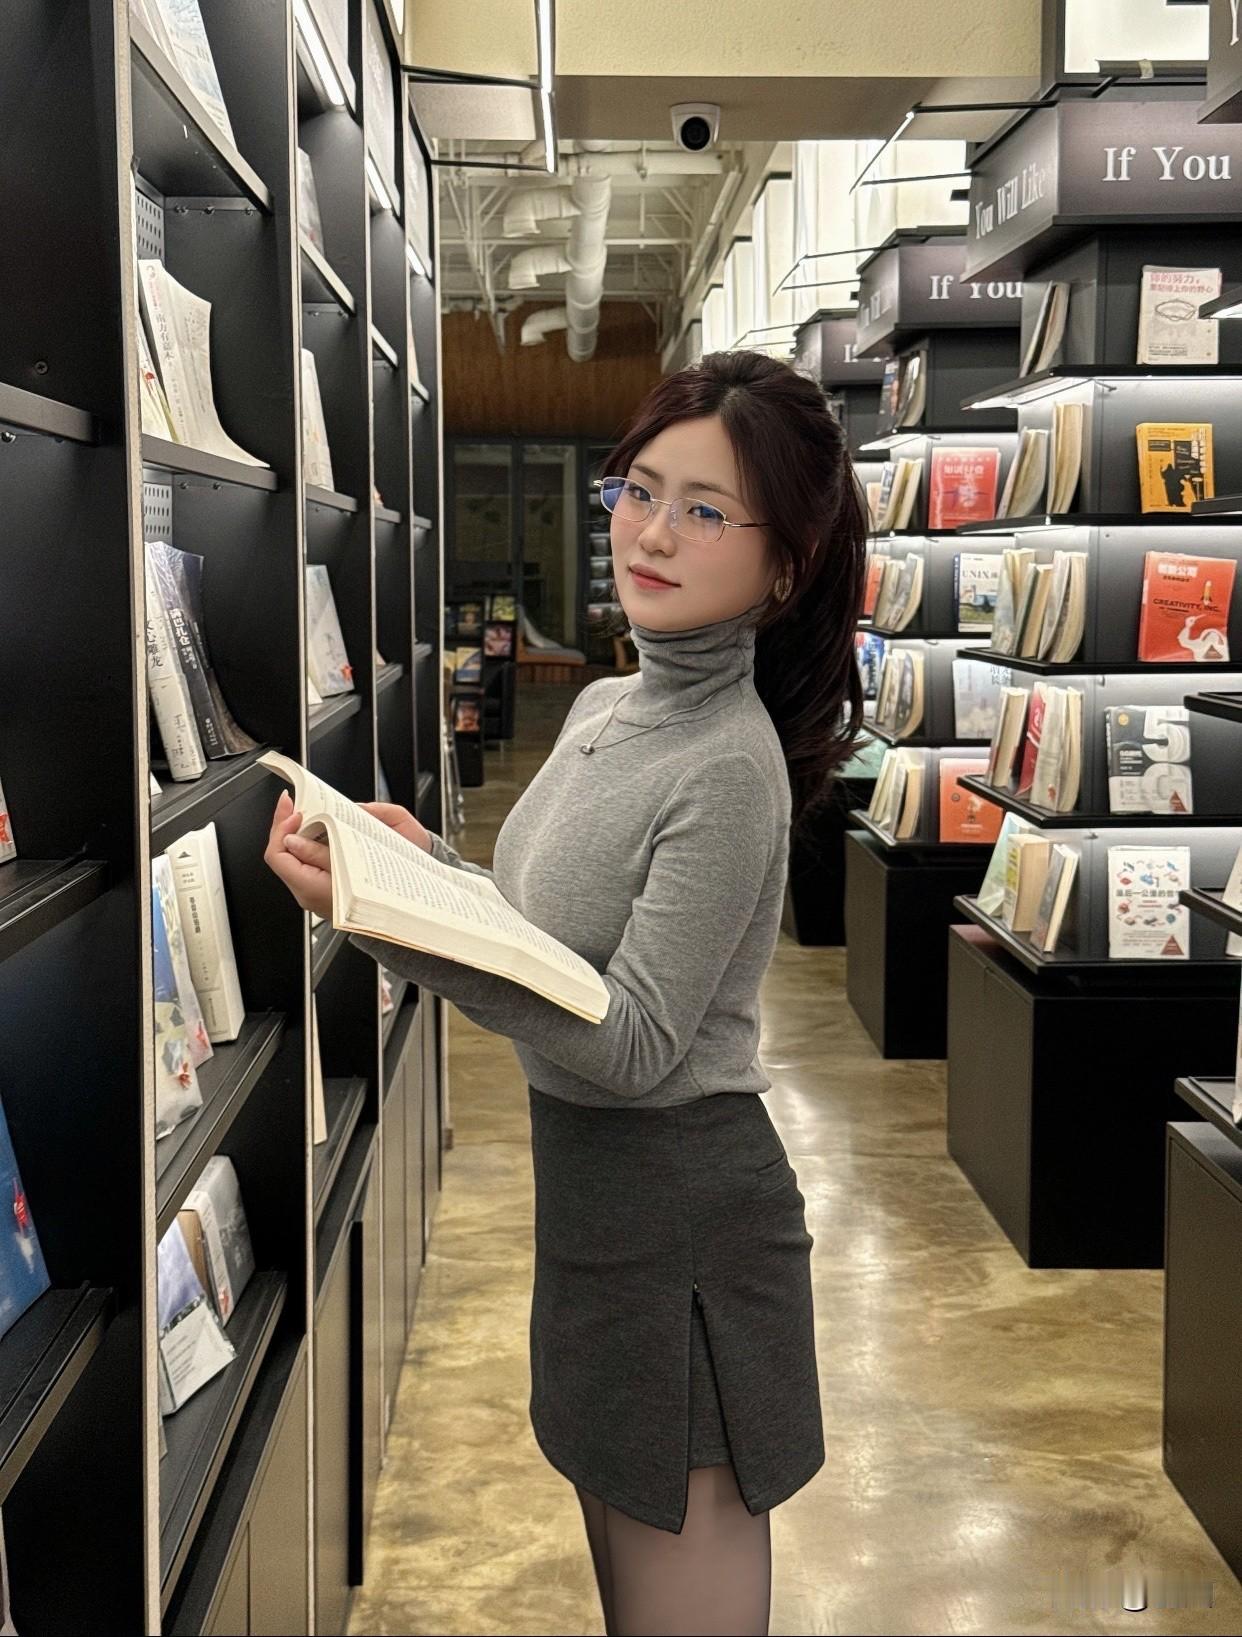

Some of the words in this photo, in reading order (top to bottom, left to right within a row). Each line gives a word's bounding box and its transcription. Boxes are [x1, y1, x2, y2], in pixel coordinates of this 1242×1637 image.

[1102, 146, 1137, 182] If
[1152, 146, 1231, 182] You
[975, 201, 994, 240] You
[996, 175, 1019, 225] Will
[1021, 162, 1046, 210] Like
[929, 275, 954, 300] If
